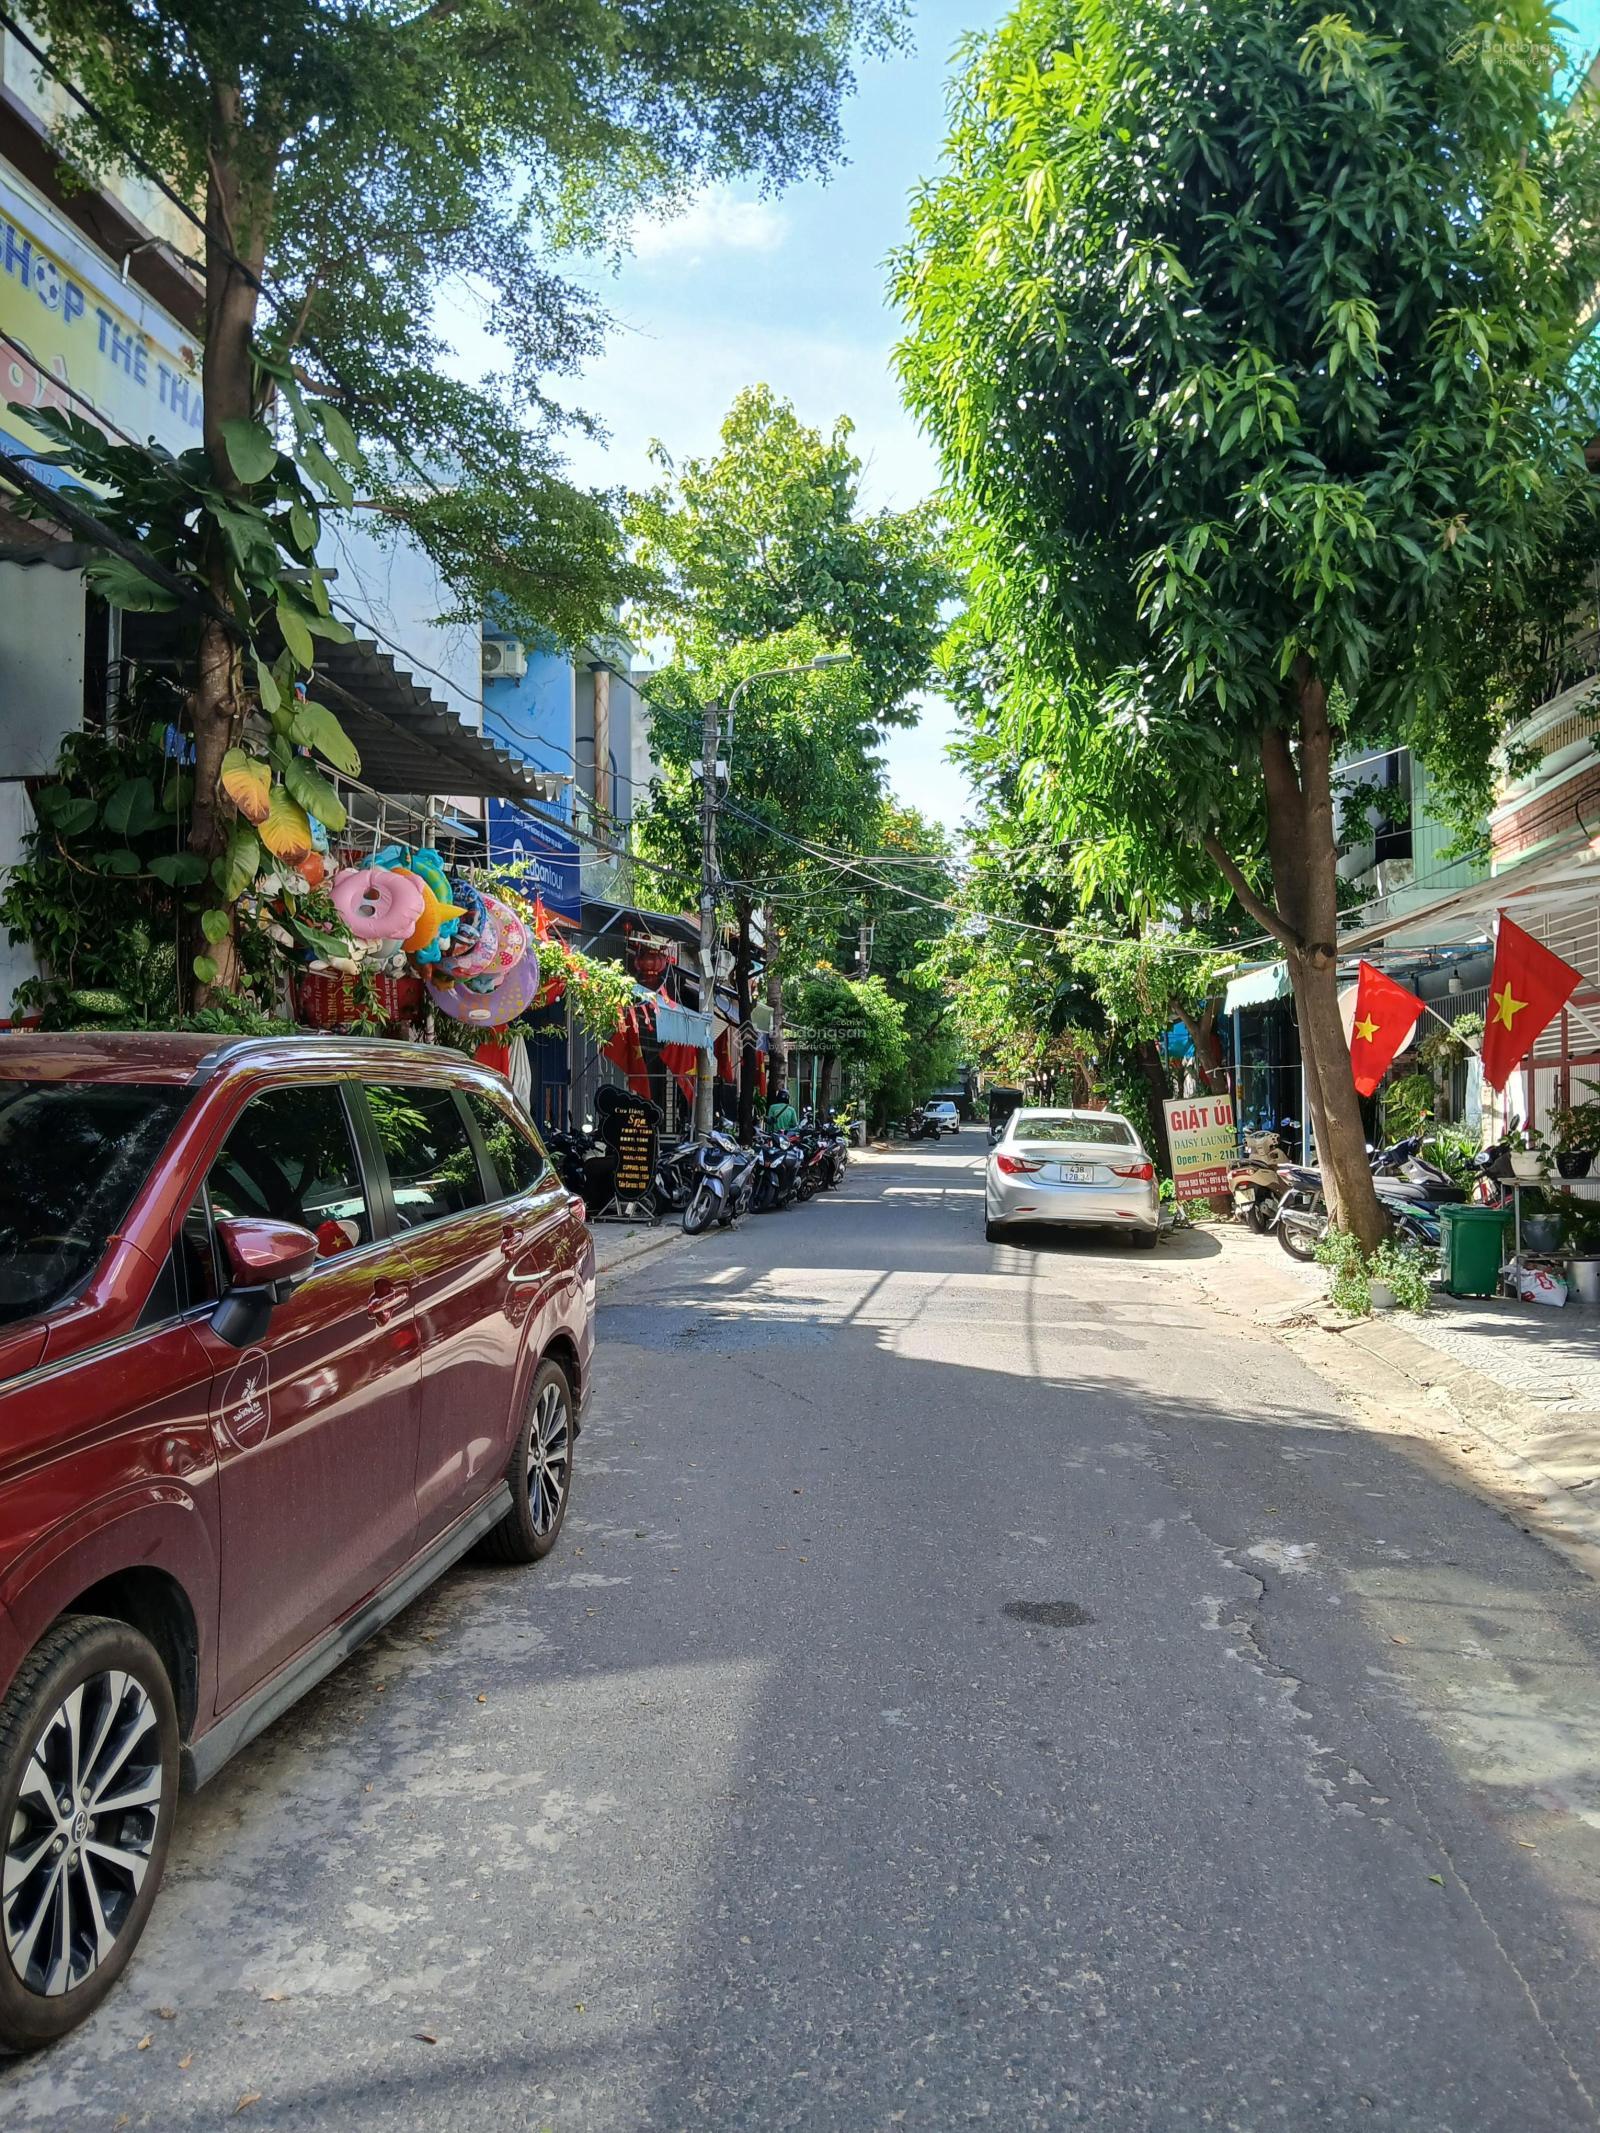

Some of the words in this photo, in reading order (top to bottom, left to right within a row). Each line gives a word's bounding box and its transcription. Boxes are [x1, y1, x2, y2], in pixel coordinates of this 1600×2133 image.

[1171, 1104, 1208, 1133] GIẶT
[1213, 1099, 1233, 1126] ỦI
[1176, 1155, 1200, 1165] Open:
[1202, 1152, 1212, 1162] 7h
